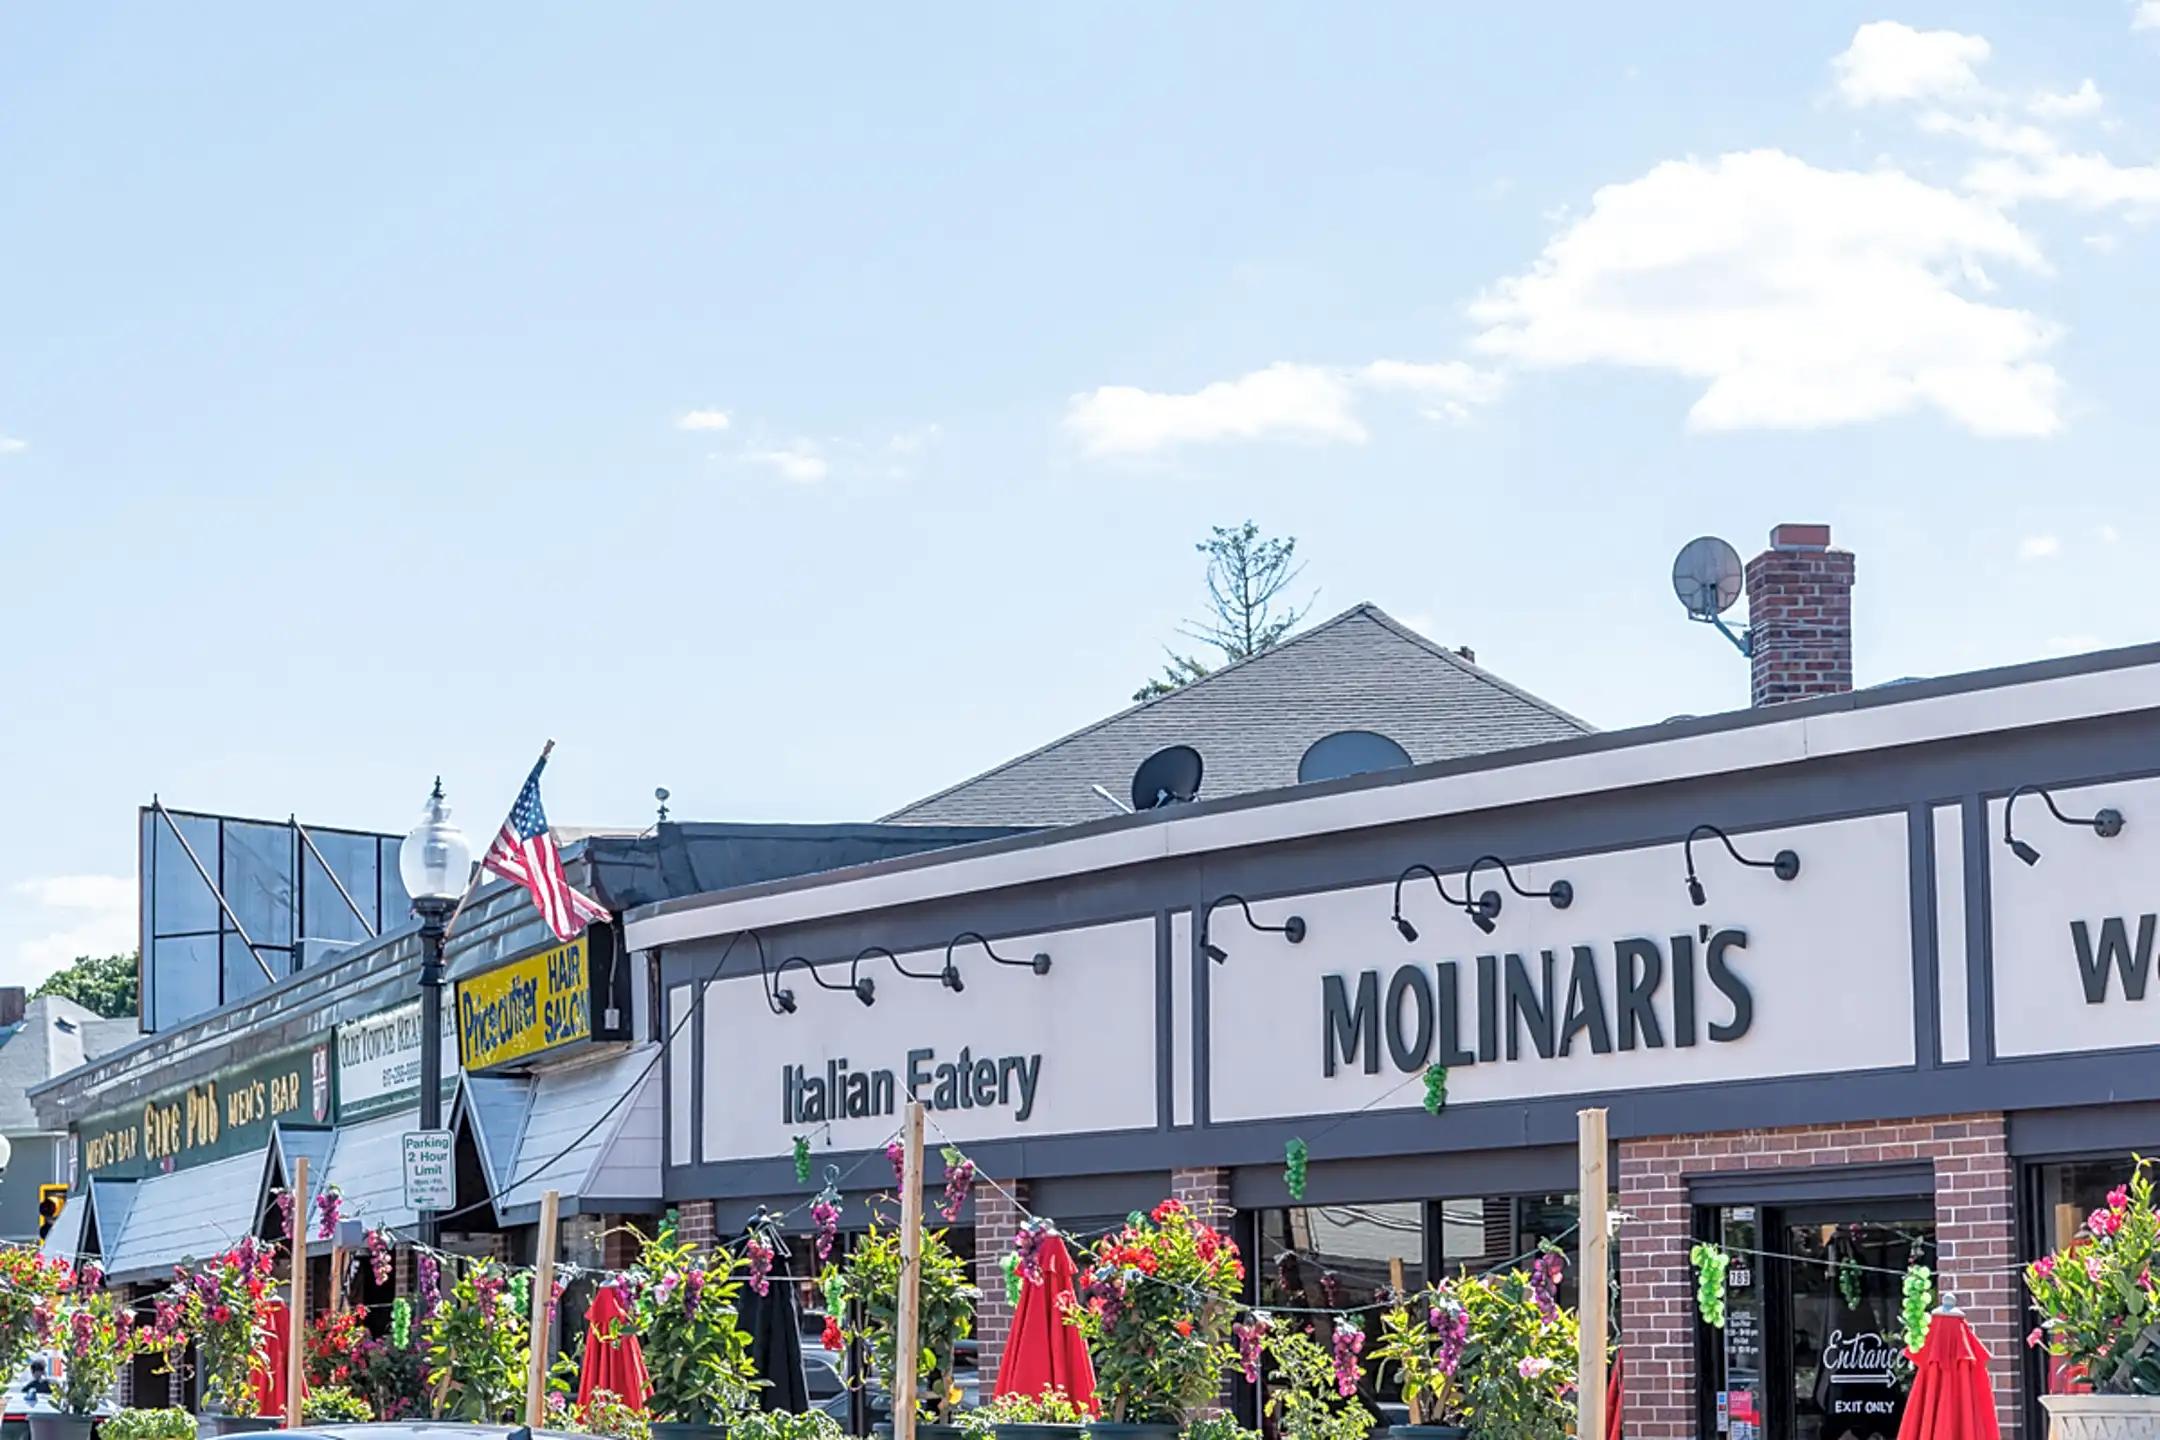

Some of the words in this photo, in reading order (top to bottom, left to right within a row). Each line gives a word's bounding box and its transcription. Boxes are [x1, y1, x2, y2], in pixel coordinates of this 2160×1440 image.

[547, 945, 581, 994] HAIR
[2068, 913, 2160, 1005] W
[544, 988, 591, 1043] SALON
[1321, 924, 1754, 1078] MOLINARI'S
[782, 1057, 895, 1125] Italian
[906, 1045, 1042, 1123] Eatery
[85, 1130, 114, 1172] MEN'S
[117, 1126, 139, 1163] BAR
[186, 1080, 219, 1149] Pub
[227, 1078, 266, 1130] MEN'S
[270, 1071, 300, 1116] BAR
[405, 1135, 449, 1149] Parking
[408, 1151, 416, 1162] 2
[420, 1151, 448, 1162] Hour
[415, 1164, 442, 1176] Limit
[1822, 1329, 1907, 1370] Entrance
[1835, 1400, 1862, 1414] EXIT
[1864, 1400, 1895, 1414] ONLY
